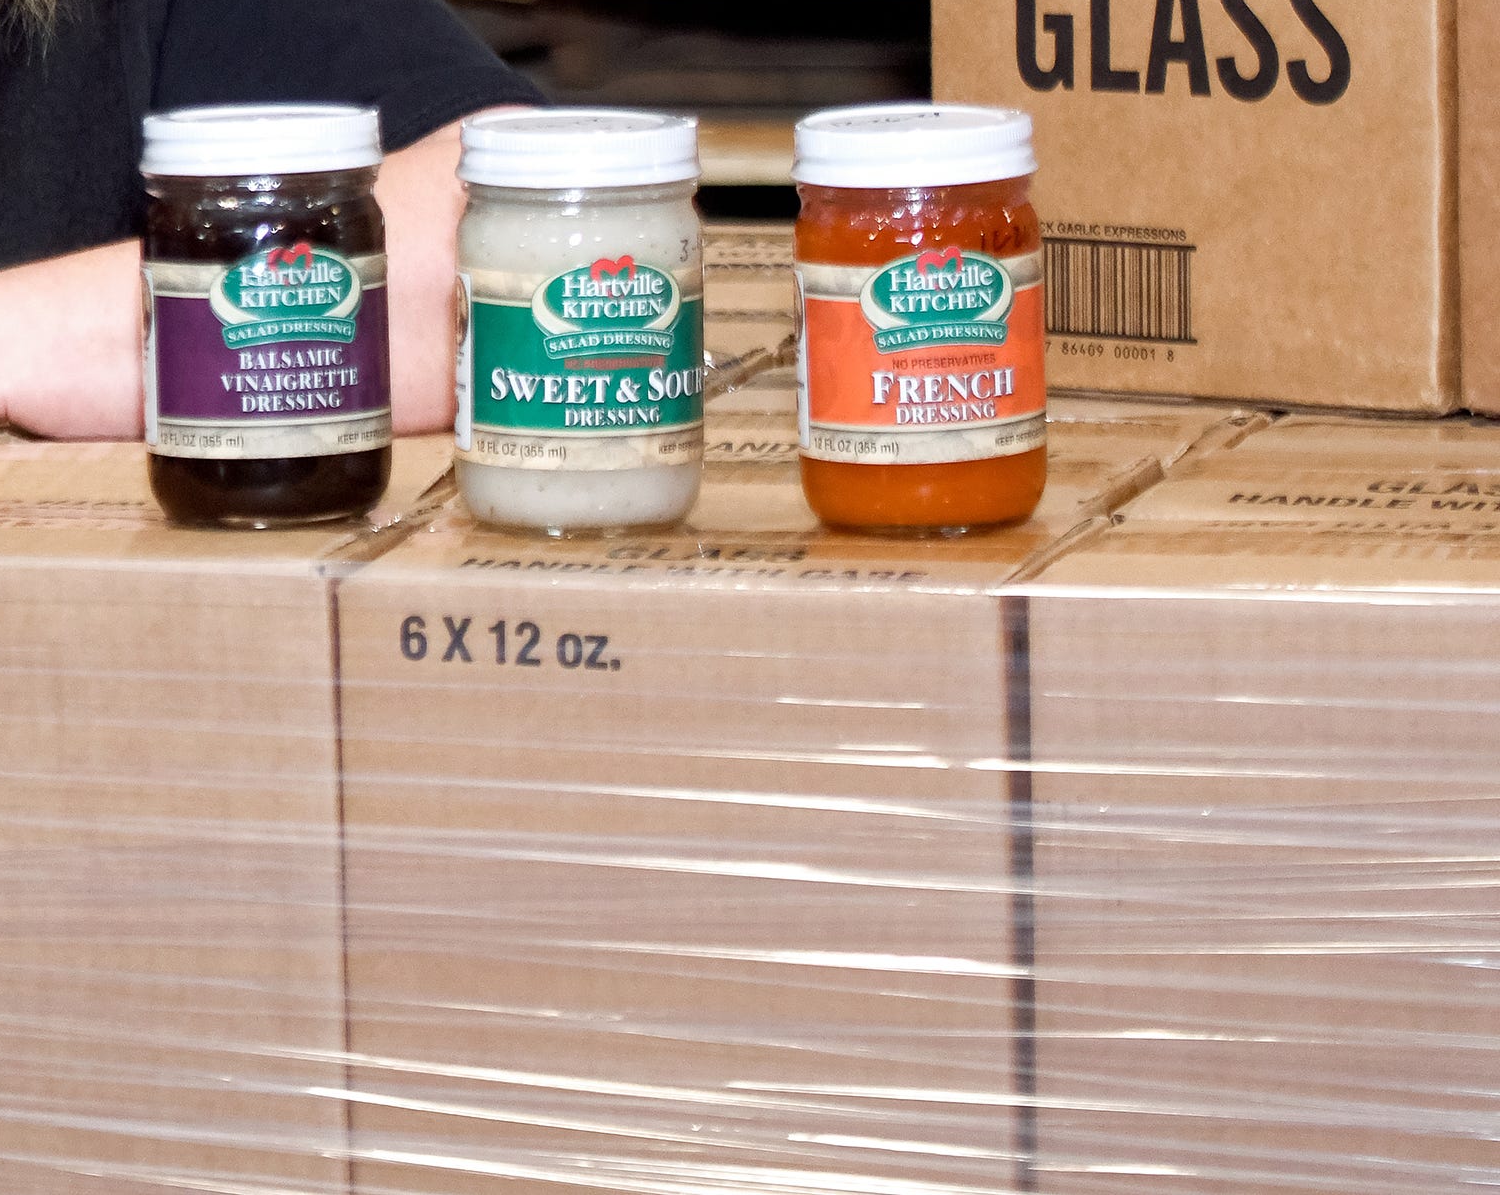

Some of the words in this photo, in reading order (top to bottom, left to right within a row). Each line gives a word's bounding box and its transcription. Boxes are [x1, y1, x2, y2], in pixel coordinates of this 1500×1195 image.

[1057, 223, 1101, 238] GARLIC
[1104, 225, 1187, 242] EXPRESSIONS
[239, 262, 344, 287] Hartville
[562, 273, 665, 298] Hartville
[889, 265, 995, 292] Hartville
[239, 287, 342, 308] KITCHEN
[562, 298, 662, 319] KITCHEN
[889, 290, 993, 313] KITCHEN
[227, 324, 278, 343] SALAD
[282, 321, 352, 337] DRESSING
[550, 334, 600, 353] SALAD
[604, 332, 671, 349] DRESSING
[878, 329, 929, 348] SALAD
[932, 325, 1003, 340] DRESSING
[239, 347, 343, 371] BALSAMIC
[892, 358, 908, 370] NO
[911, 353, 996, 370] PRESERVATIVES
[1114, 345, 1156, 362] 00001
[1167, 350, 1174, 363] 8
[220, 366, 360, 393] VINAIGRETTE
[490, 366, 611, 404] SWEET
[615, 376, 642, 403] &
[871, 366, 1015, 405] FRENCH
[241, 389, 342, 414] DRESSING
[895, 401, 995, 425] DRESSING
[564, 405, 662, 428] DRESSING
[487, 440, 499, 455] FL
[501, 442, 516, 457] OZ
[519, 444, 545, 461] (355
[547, 444, 567, 460] ml)
[824, 438, 835, 452] FL
[838, 439, 851, 454] OZ
[853, 440, 877, 457] (355
[880, 440, 899, 456] ml)
[1227, 493, 1417, 509] HANDLE
[400, 615, 428, 661] 6
[443, 616, 474, 663] X
[489, 618, 542, 667] 12
[556, 632, 622, 672] oz.
